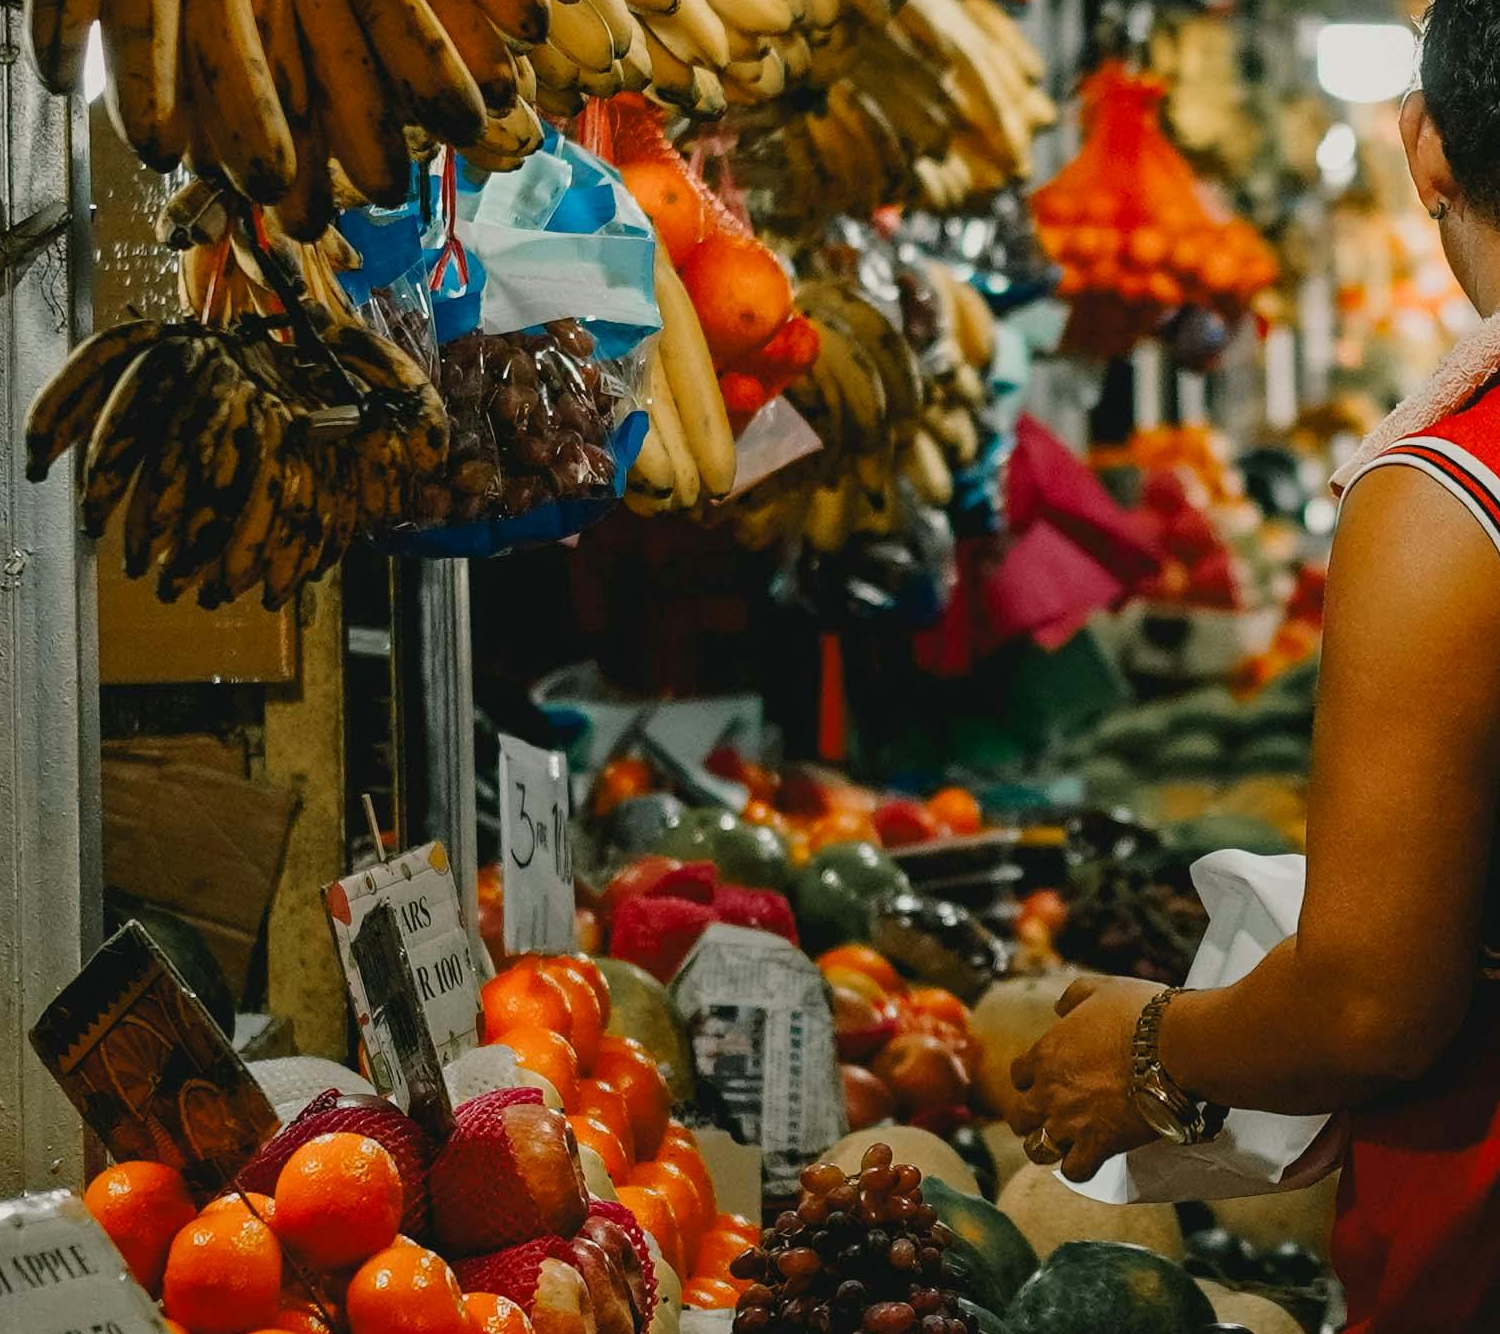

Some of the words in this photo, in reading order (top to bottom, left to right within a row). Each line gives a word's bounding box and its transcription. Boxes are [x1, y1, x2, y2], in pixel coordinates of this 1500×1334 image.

[511, 782, 535, 869] 3
[398, 896, 431, 935] ARS
[435, 953, 464, 996] 100
[13, 1245, 98, 1288] APPLE
